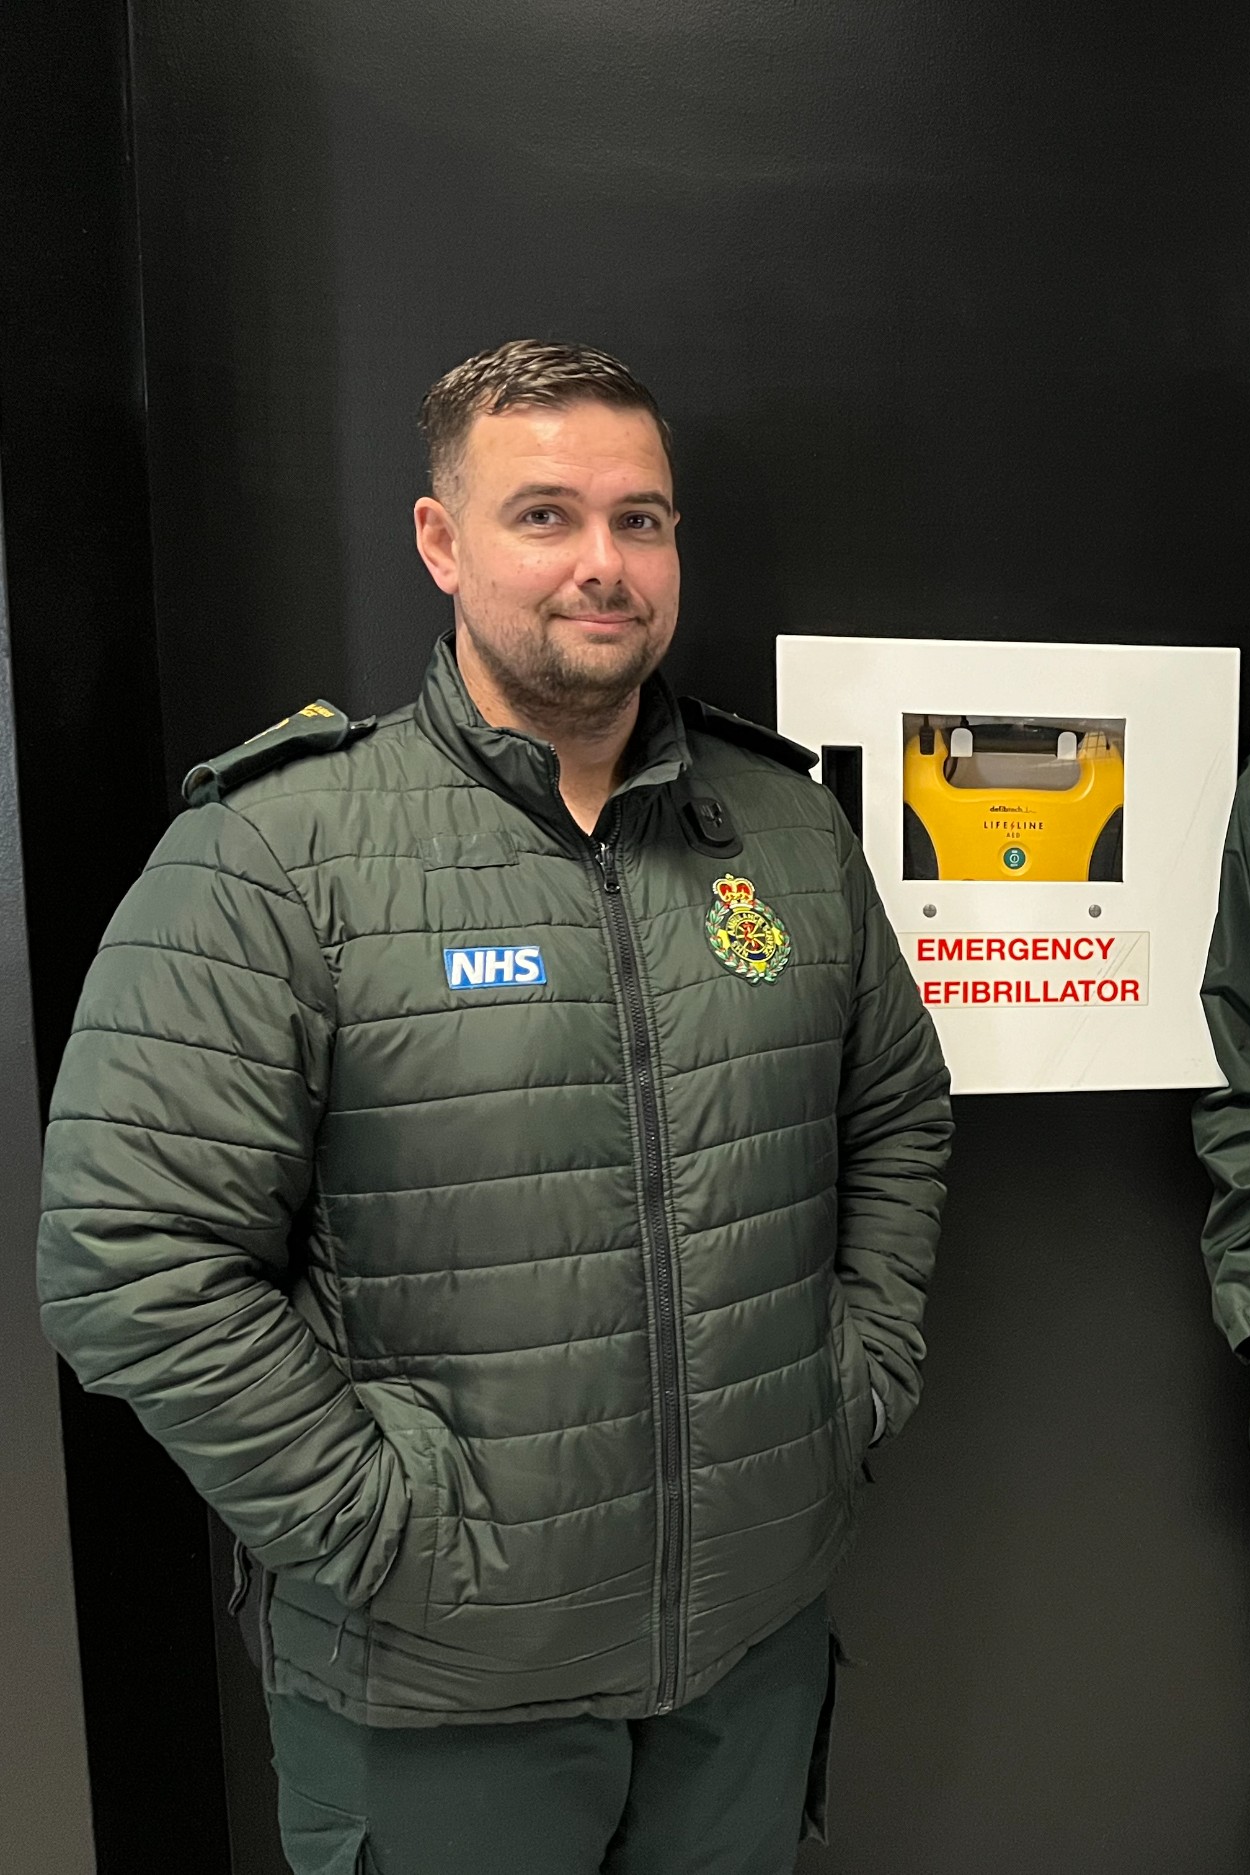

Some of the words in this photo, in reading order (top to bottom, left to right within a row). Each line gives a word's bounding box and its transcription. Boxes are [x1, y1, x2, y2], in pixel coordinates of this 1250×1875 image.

[917, 938, 1115, 961] EMERGENCY
[451, 949, 541, 985] NHS
[916, 980, 1140, 1003] EFIBRILLATOR
